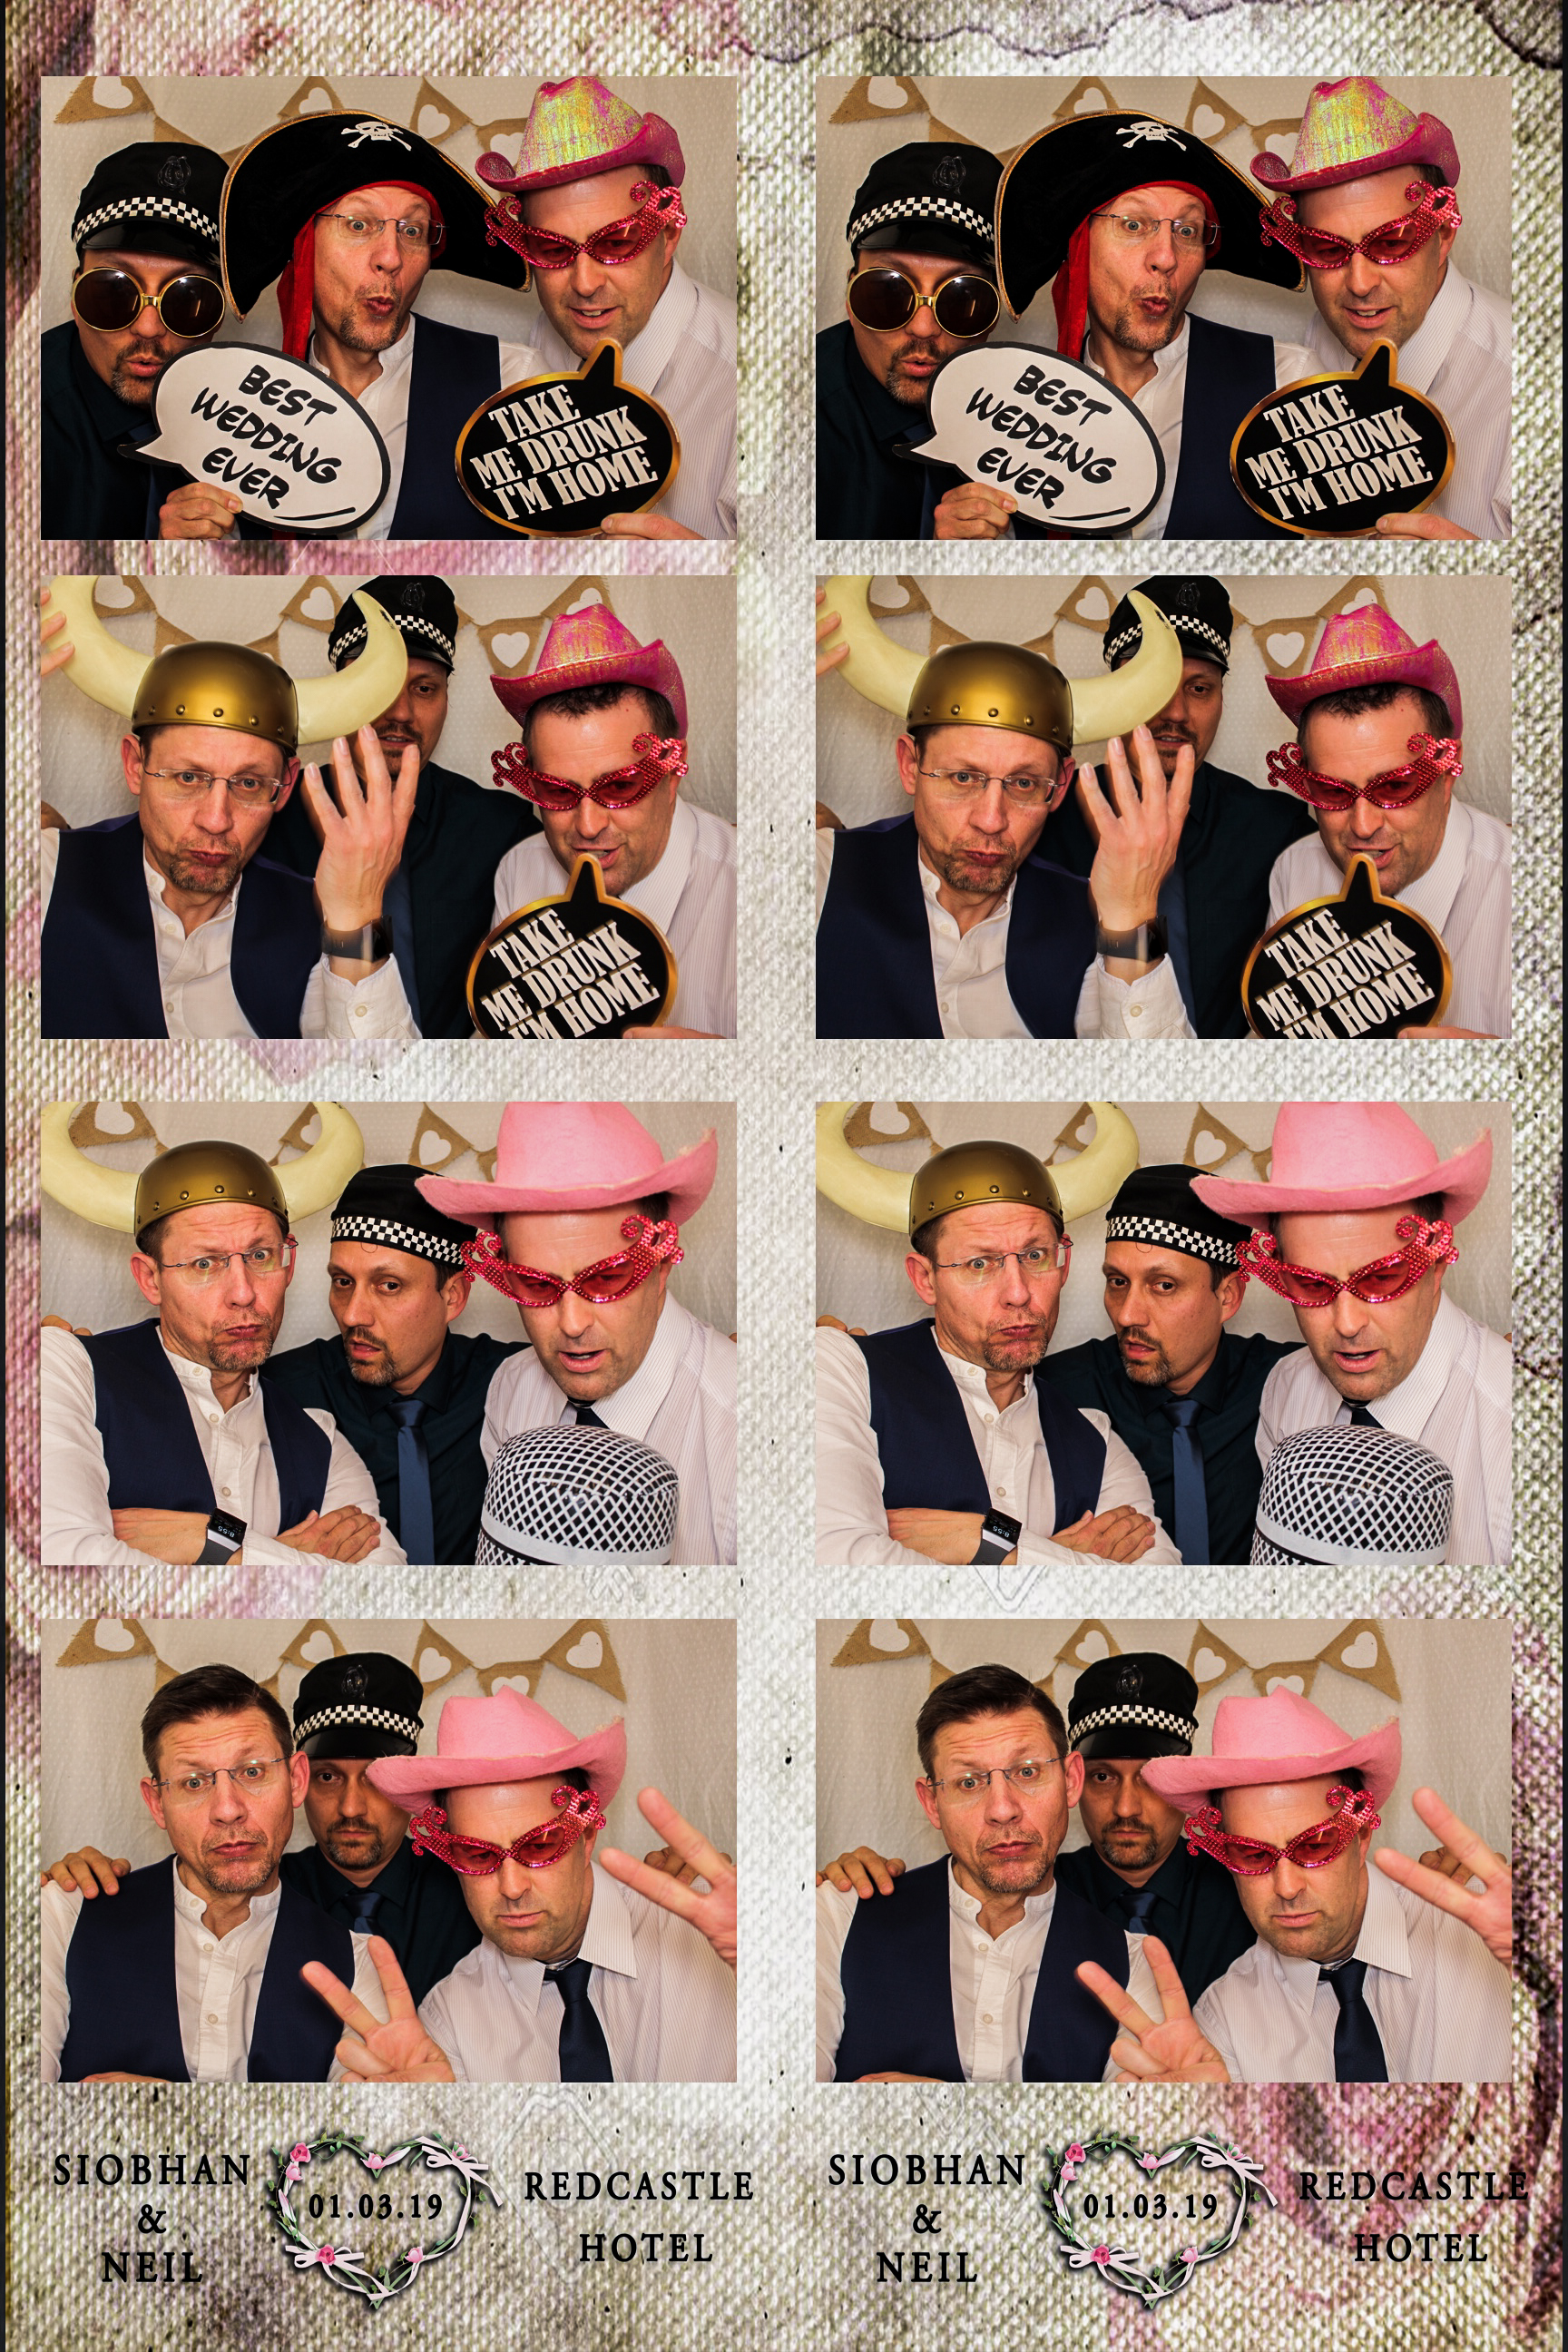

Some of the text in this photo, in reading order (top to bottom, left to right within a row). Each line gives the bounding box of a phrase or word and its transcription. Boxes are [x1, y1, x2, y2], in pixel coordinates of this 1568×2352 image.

[239, 364, 338, 426] BEST
[487, 384, 582, 443] TAKE
[1014, 364, 1112, 426] BEST
[1262, 384, 1357, 443] TAKE
[191, 387, 342, 484] WEDDING
[469, 406, 648, 489] ME DRUNK
[965, 387, 1117, 484] WEDDING
[1244, 406, 1423, 489] ME DRUNK
[201, 446, 289, 510] EVER
[493, 446, 659, 521] I'M HOME
[976, 446, 1064, 510] EVER
[1268, 446, 1434, 521] I'M HOME
[480, 919, 642, 1032] ME DRUNK
[488, 907, 575, 979] TAKE
[1255, 919, 1416, 1032] ME DRUNK
[1263, 907, 1350, 979] TAKE
[554, 958, 661, 1038] HOME
[1328, 958, 1436, 1038] HOME
